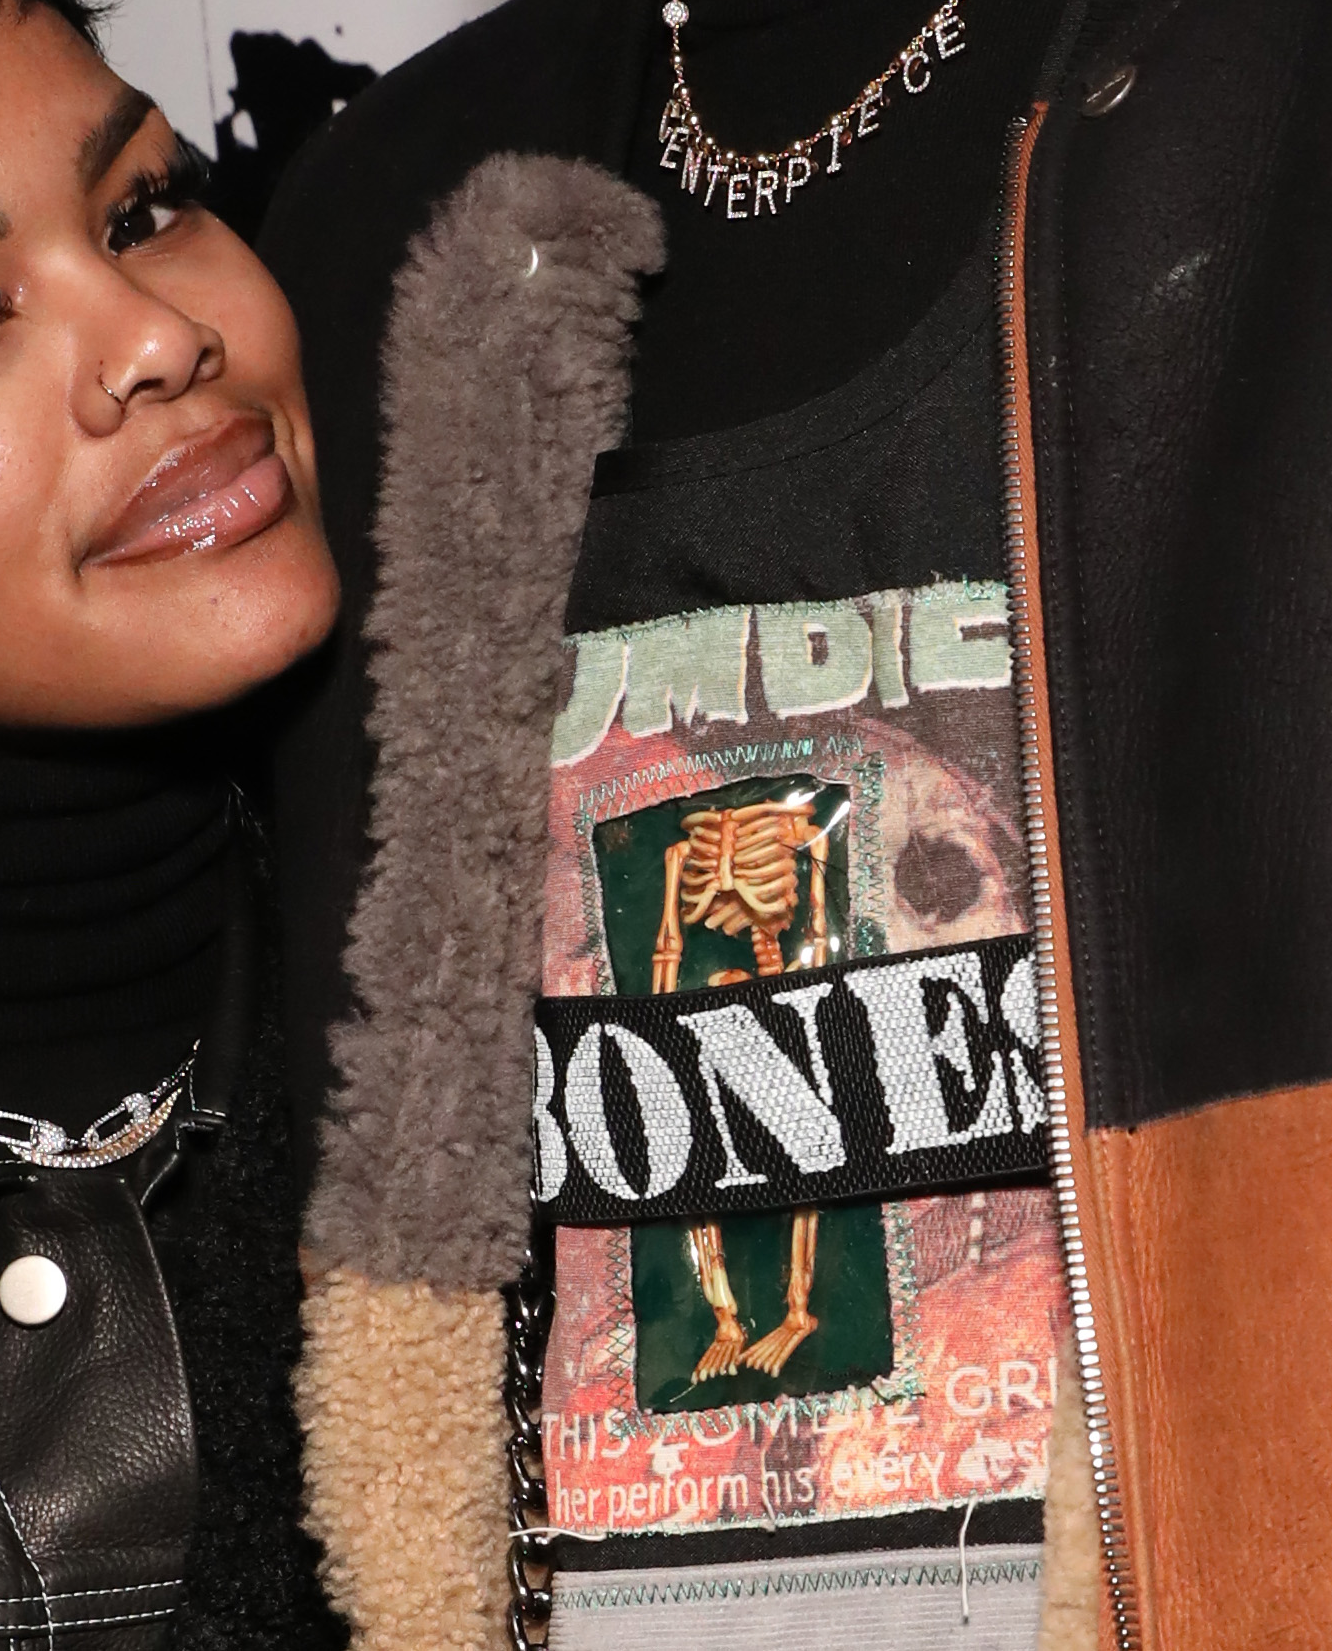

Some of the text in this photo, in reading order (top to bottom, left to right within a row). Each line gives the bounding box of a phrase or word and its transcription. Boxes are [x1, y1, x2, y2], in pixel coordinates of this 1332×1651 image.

[542, 1410, 630, 1461] THIS
[555, 1469, 601, 1523] her
[608, 1469, 748, 1529] perform
[830, 1450, 946, 1500] every
